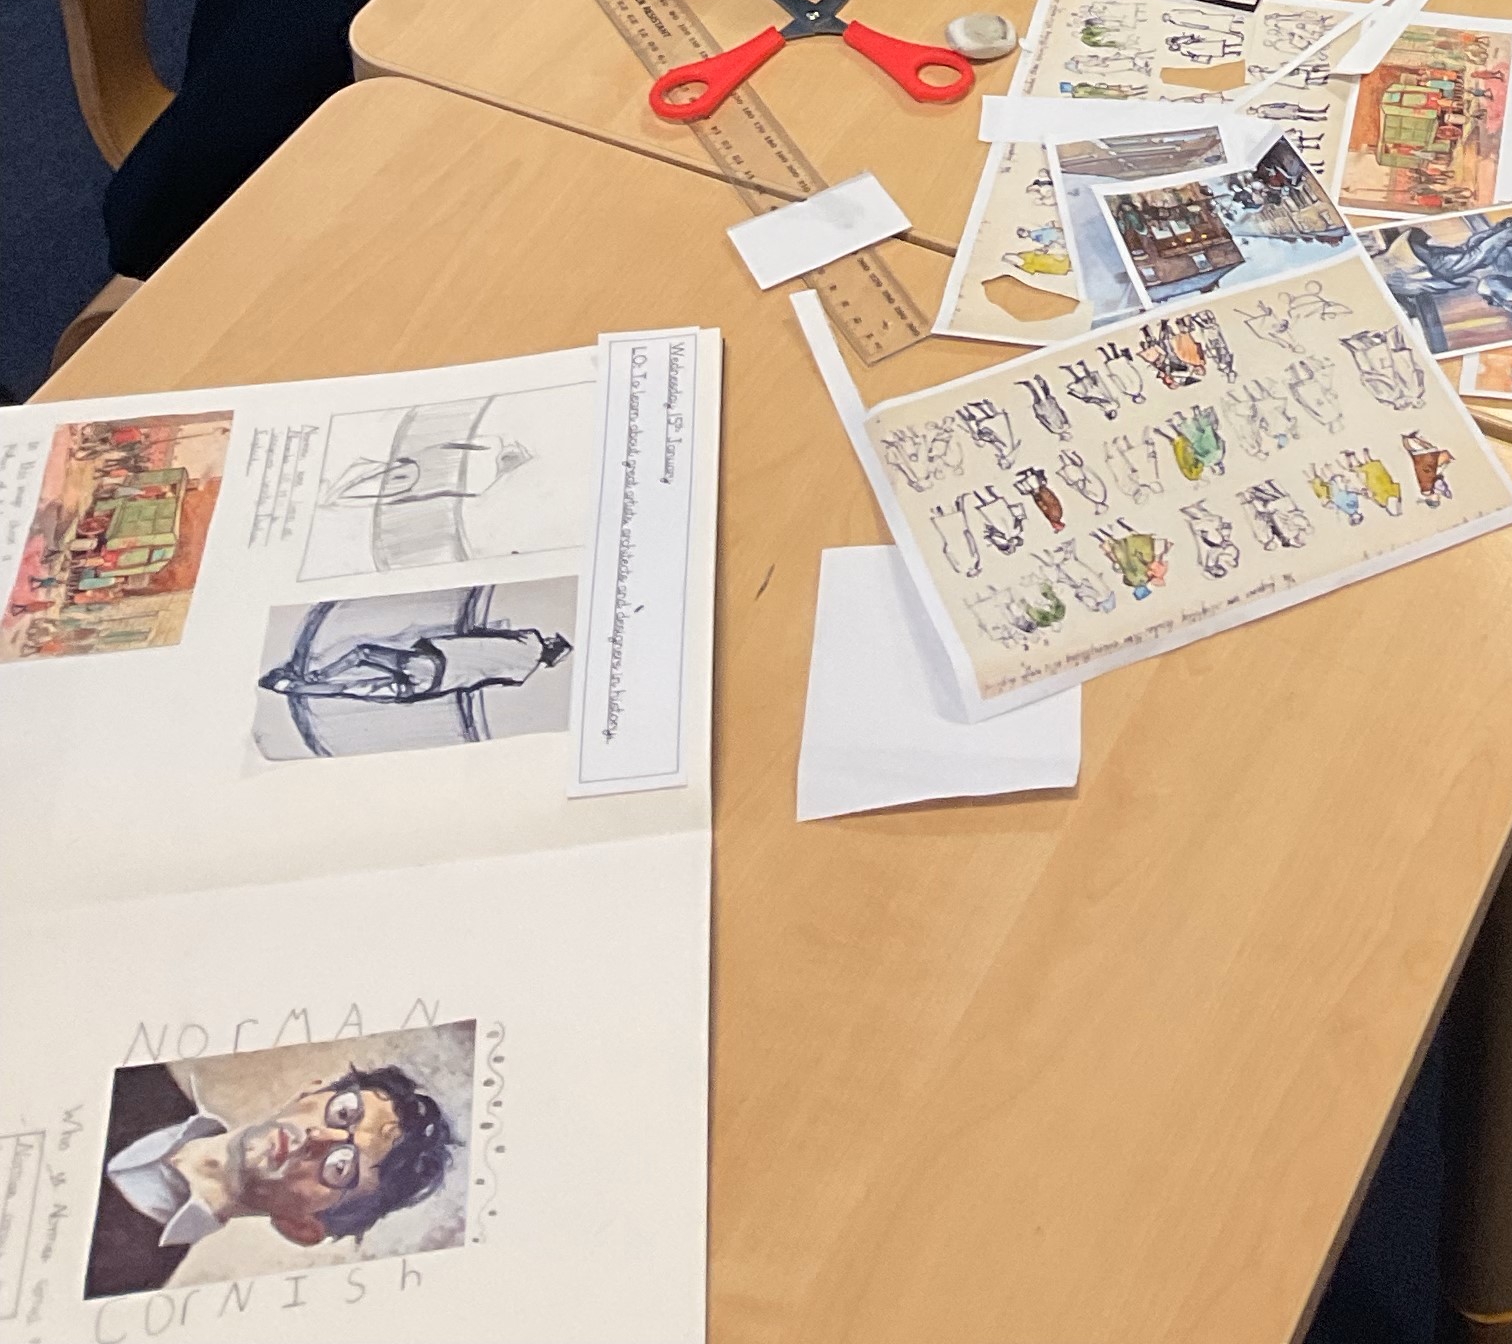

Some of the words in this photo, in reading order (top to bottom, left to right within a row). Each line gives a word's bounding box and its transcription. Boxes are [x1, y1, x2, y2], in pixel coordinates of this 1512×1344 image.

[641, 3, 672, 41] RESISTANT
[663, 341, 687, 411] Wednesday
[660, 437, 683, 485] January
